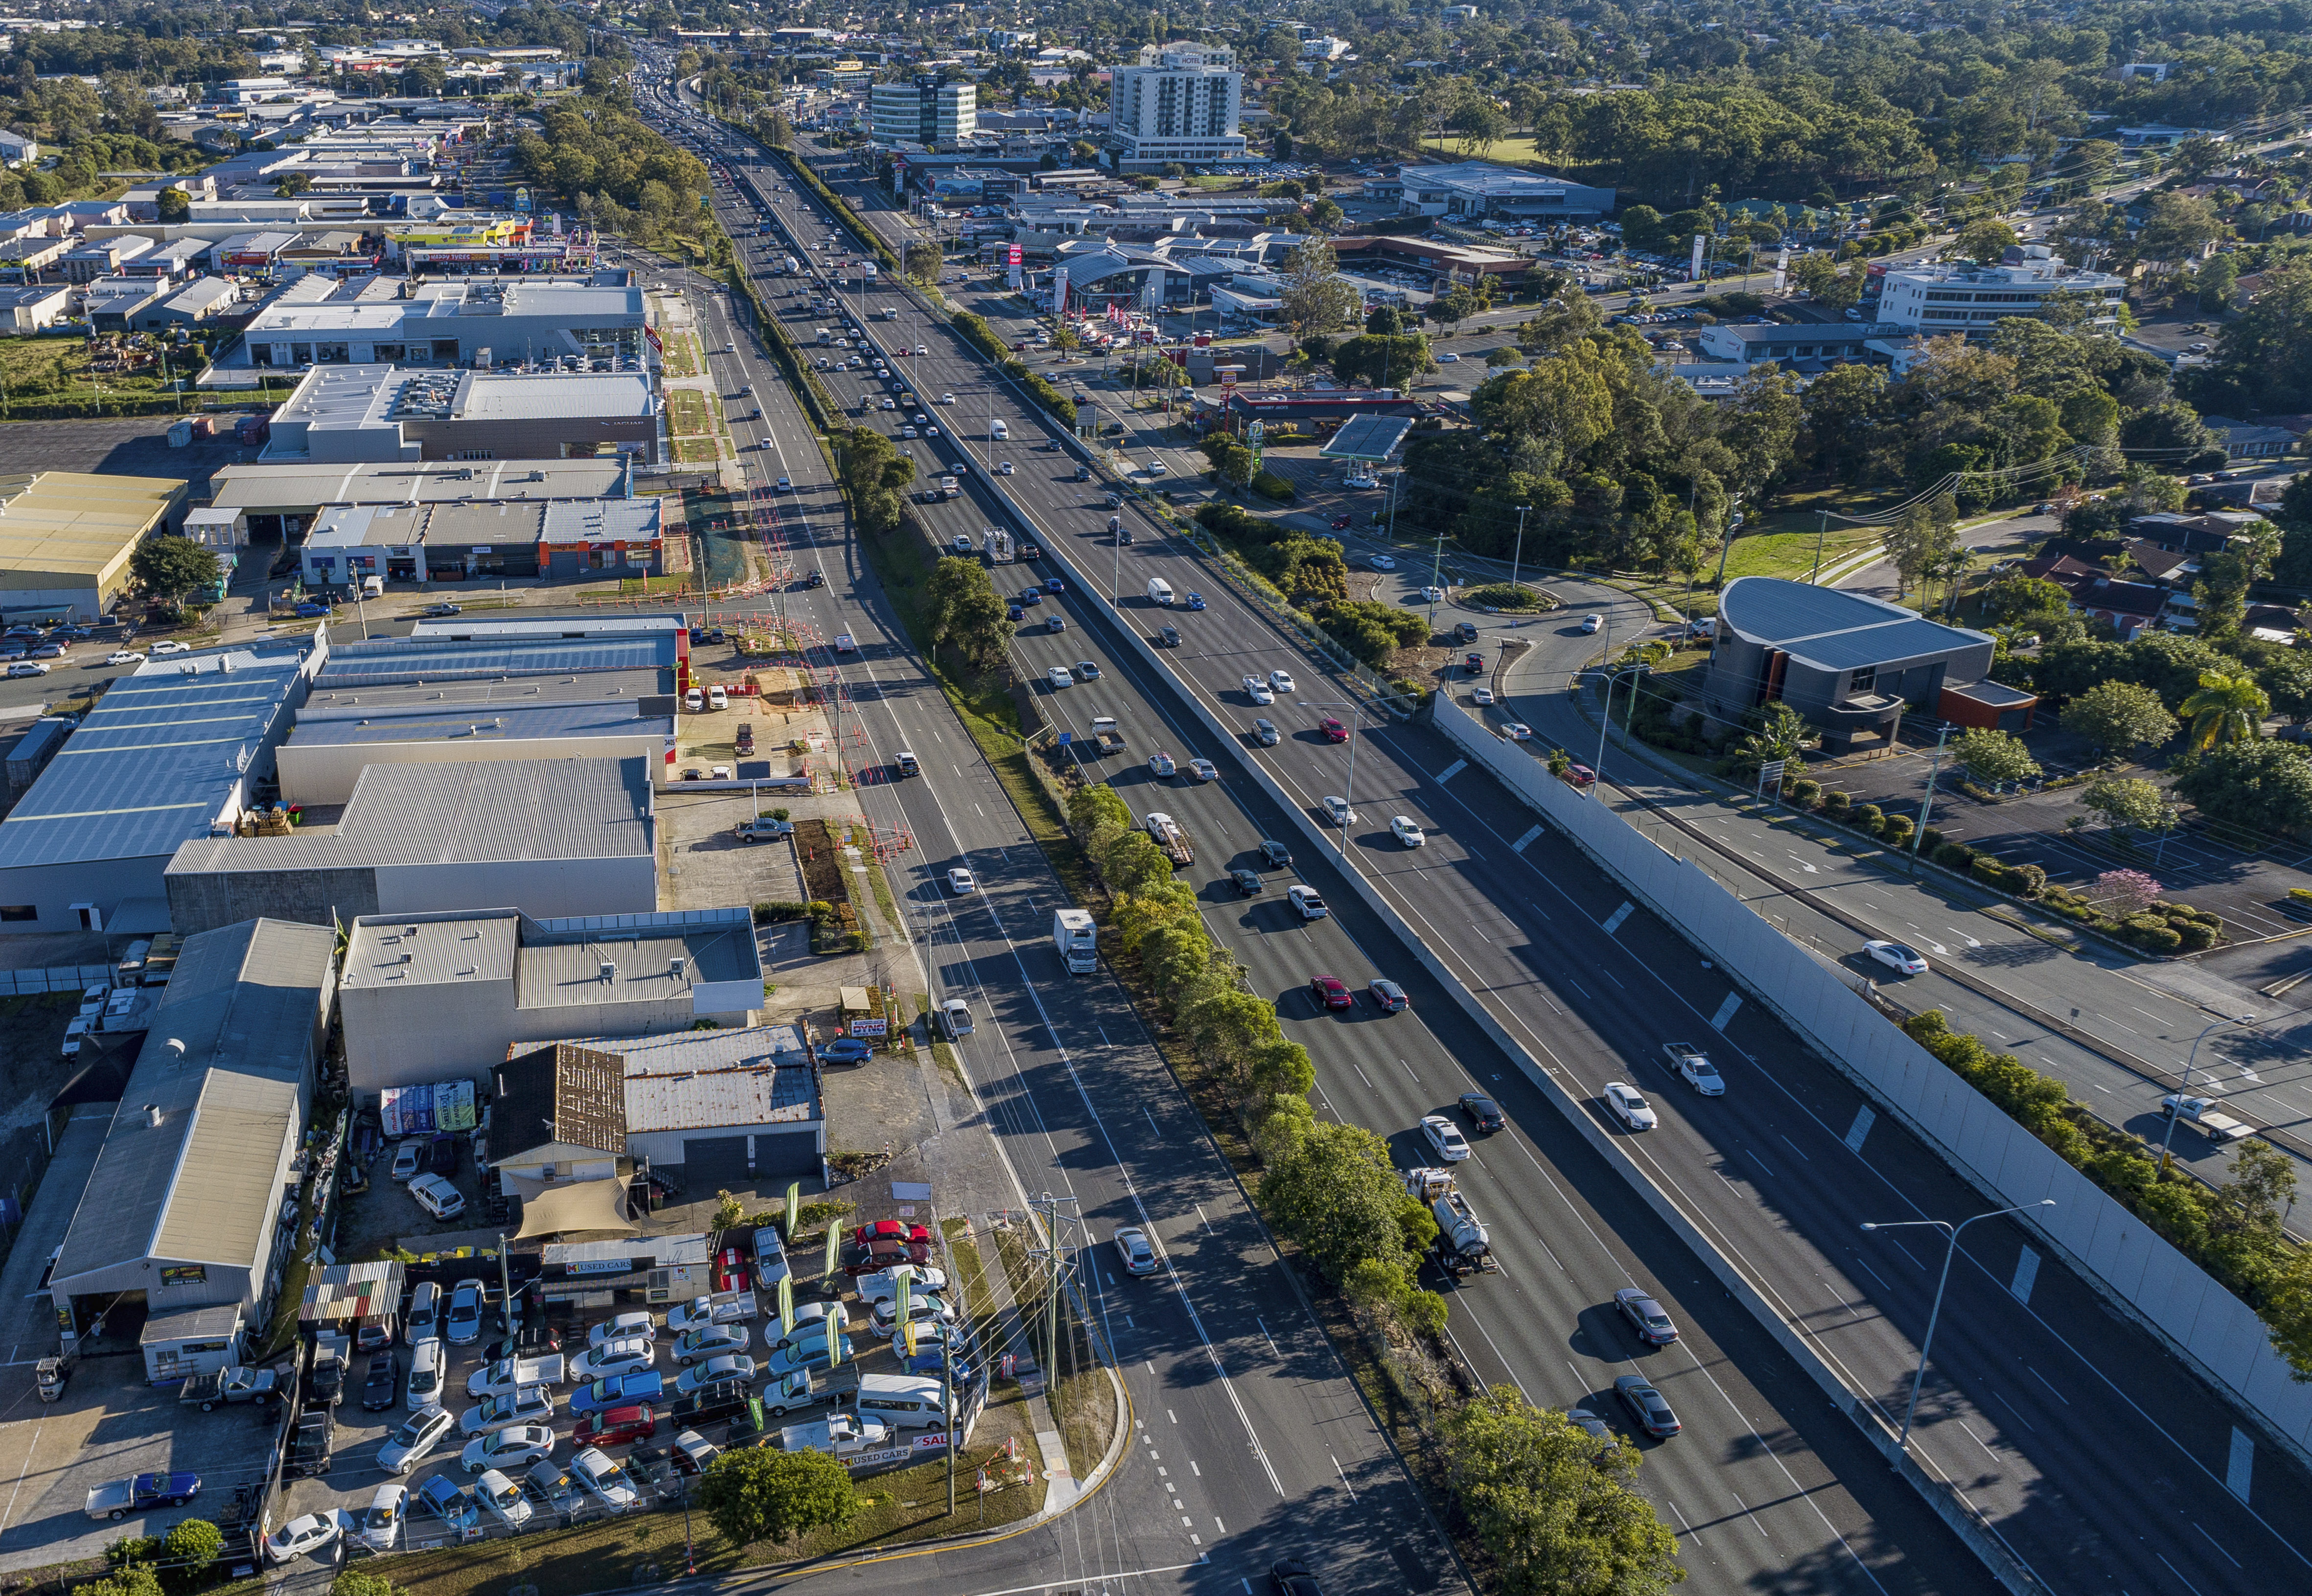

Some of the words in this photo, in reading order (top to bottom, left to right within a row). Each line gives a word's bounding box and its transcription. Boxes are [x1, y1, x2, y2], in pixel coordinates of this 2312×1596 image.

[647, 333, 660, 346] 3391
[854, 1024, 885, 1033] DYNO
[441, 1095, 450, 1123] TICKETEK
[580, 1262, 605, 1271] USED
[607, 1260, 631, 1269] CARS
[922, 1435, 948, 1446] SAL
[854, 1454, 880, 1464] USED
[881, 1449, 908, 1459] CARS
